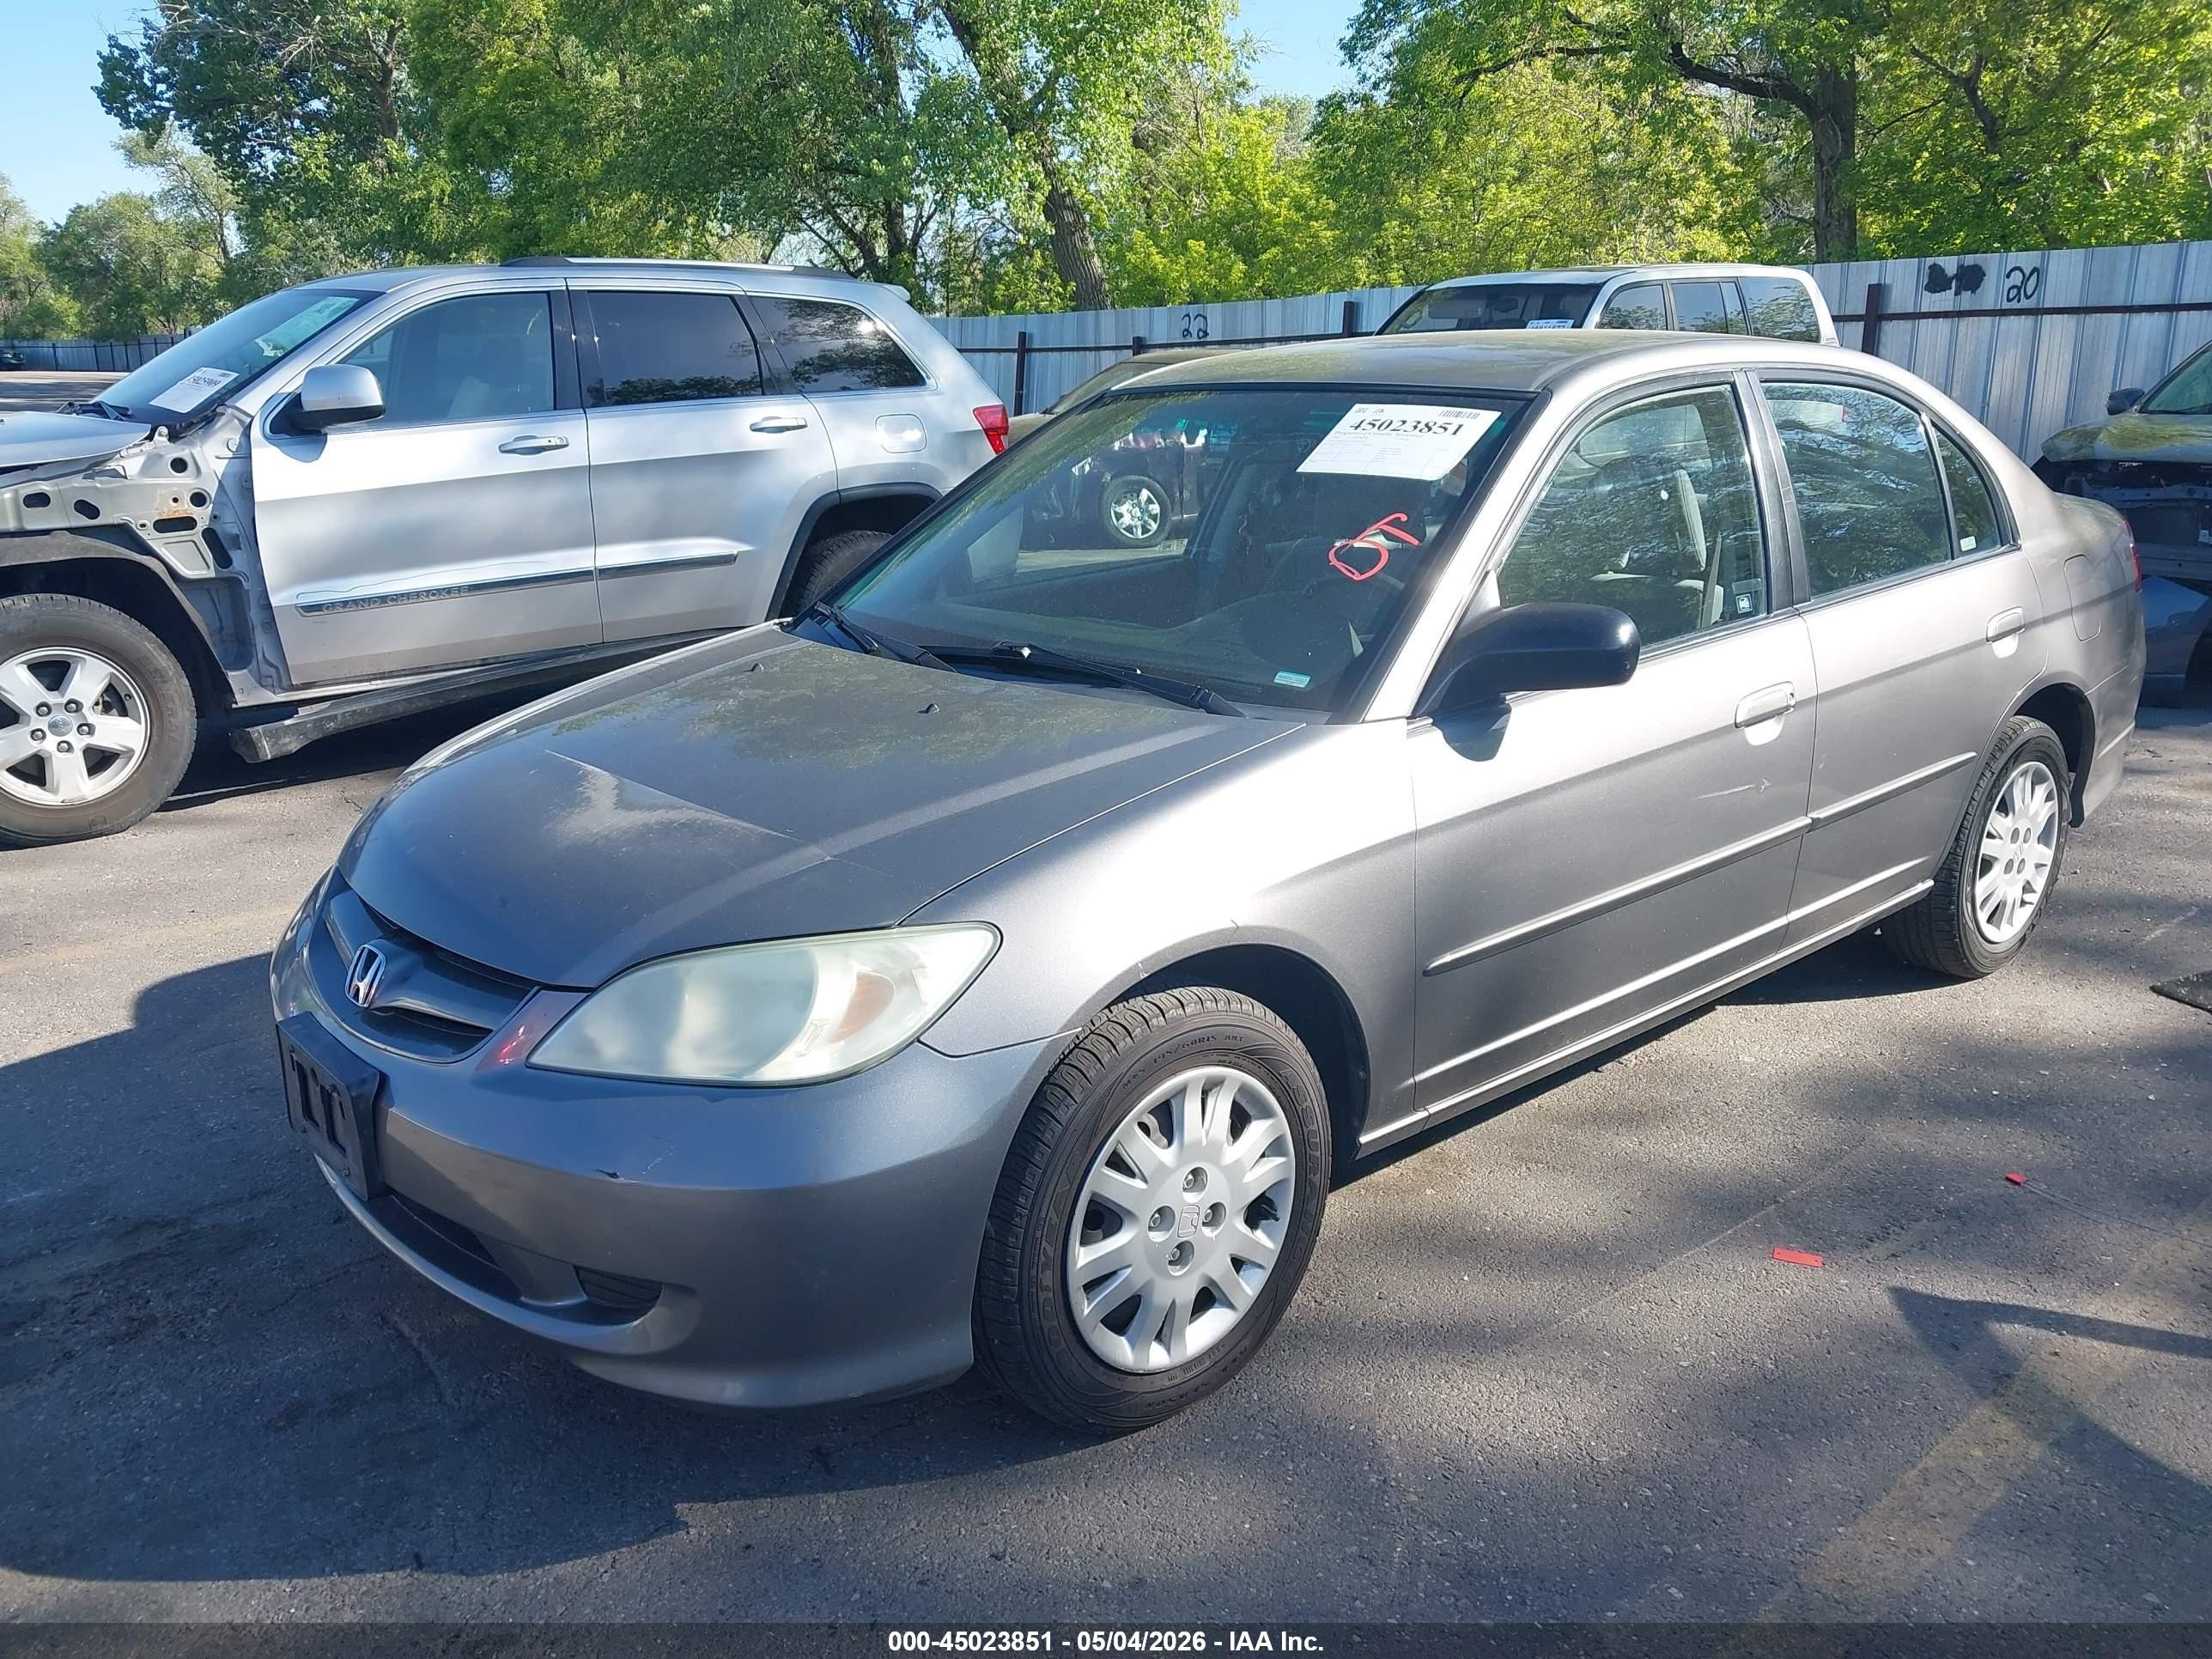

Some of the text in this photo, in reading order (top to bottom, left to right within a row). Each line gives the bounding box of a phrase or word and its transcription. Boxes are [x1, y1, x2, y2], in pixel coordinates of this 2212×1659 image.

[2005, 265, 2040, 303] 20
[1182, 313, 1209, 339] 22
[1349, 418, 1465, 435] 45023851
[322, 586, 469, 613] GRAND CHEROKEE
